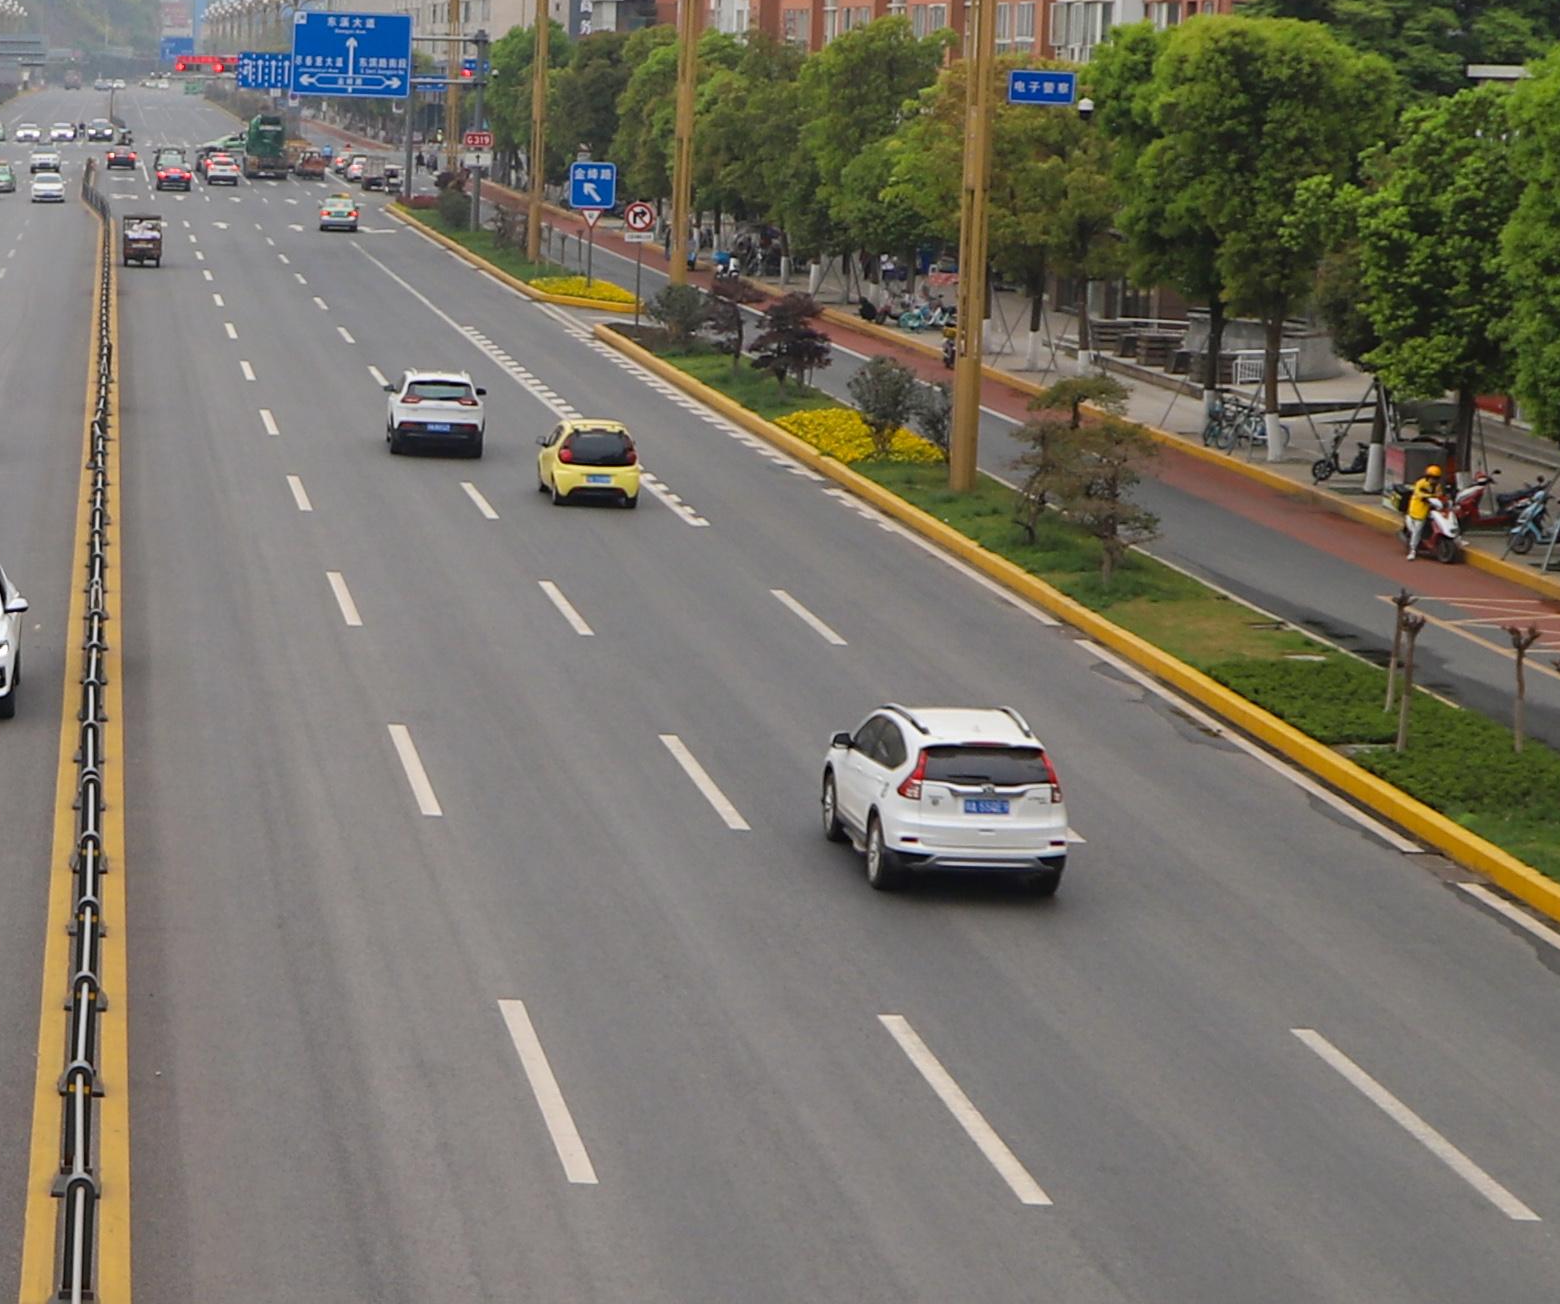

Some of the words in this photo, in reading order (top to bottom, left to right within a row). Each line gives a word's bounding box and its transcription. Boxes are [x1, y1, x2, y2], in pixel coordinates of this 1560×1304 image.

[1013, 80, 1070, 94] 电子警察
[467, 135, 490, 145] G319
